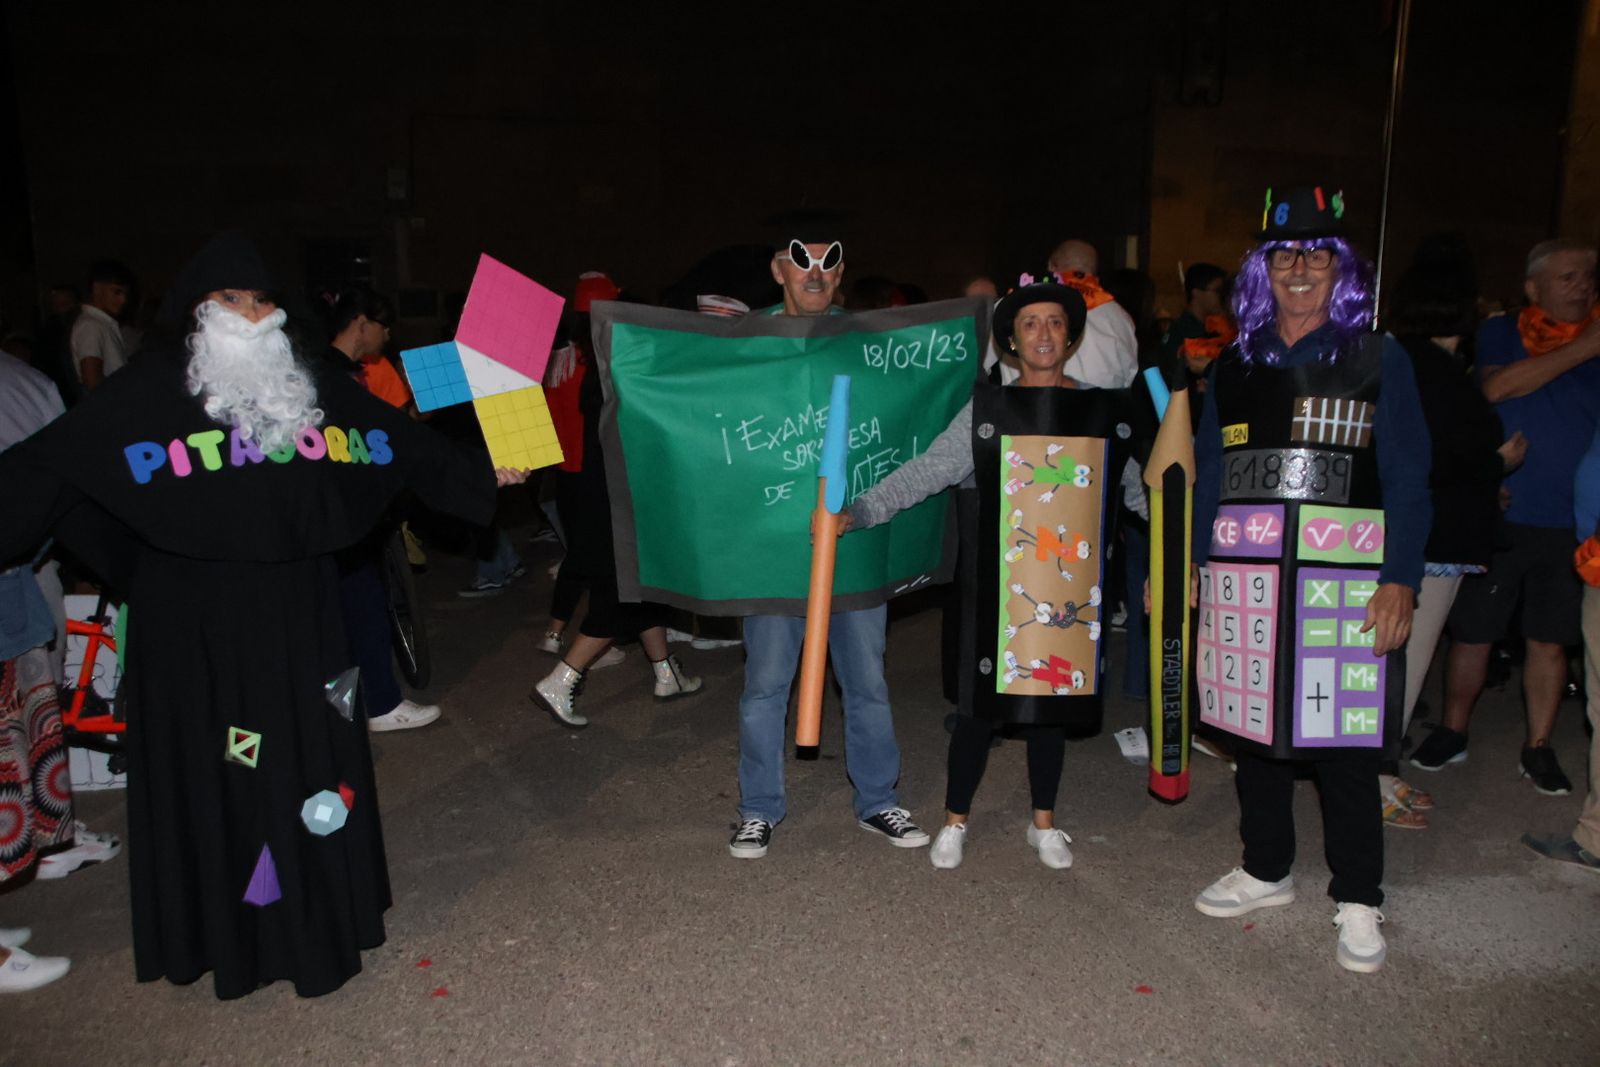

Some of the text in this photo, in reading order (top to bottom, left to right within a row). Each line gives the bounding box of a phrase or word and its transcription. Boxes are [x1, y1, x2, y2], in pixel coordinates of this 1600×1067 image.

[863, 329, 968, 374] 18/02/23
[715, 403, 831, 465] ¡EXAME
[783, 417, 882, 471] SORESA
[764, 436, 918, 506] DE ATES!
[1223, 575, 1233, 600] 8
[1253, 576, 1265, 603] 9
[1204, 614, 1264, 644] 4 5 6
[1225, 655, 1235, 680] 2
[1252, 660, 1262, 686] 3
